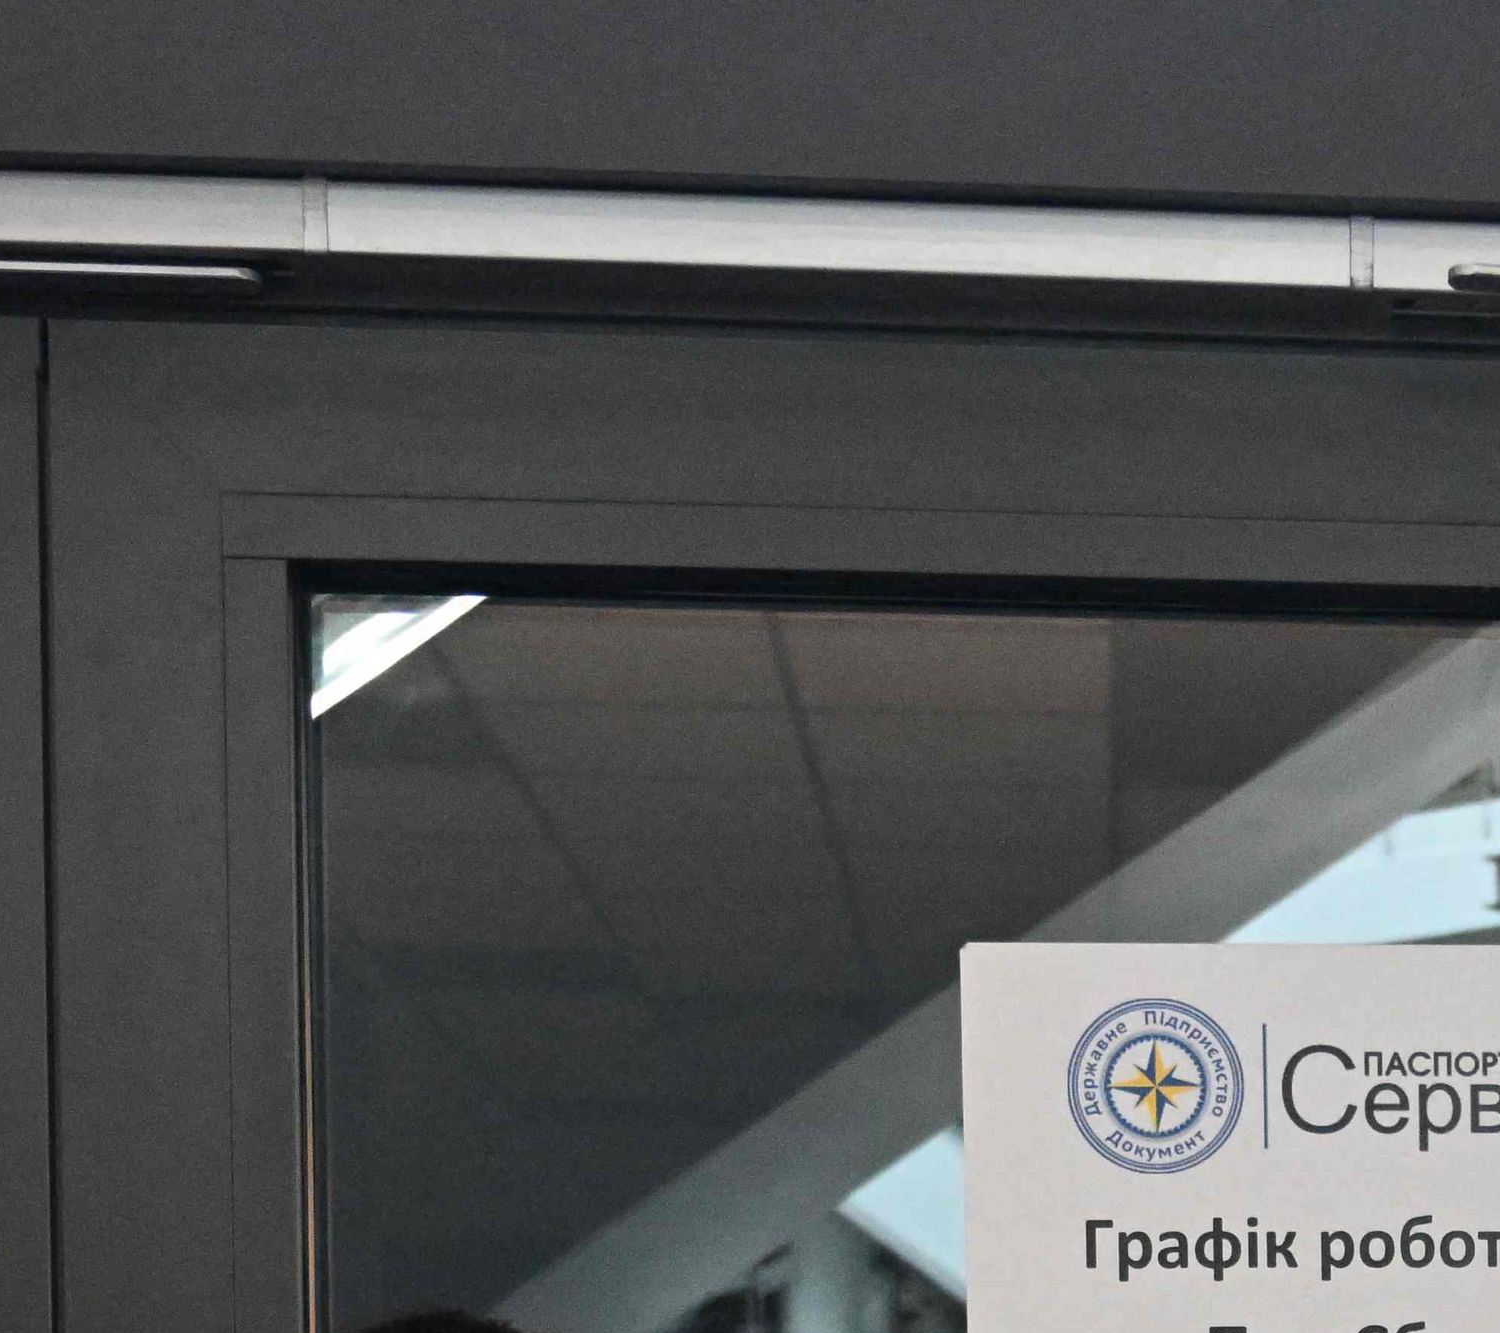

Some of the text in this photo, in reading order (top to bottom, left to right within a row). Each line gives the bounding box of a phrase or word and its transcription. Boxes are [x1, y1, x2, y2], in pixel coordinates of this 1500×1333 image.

[1084, 1011, 1228, 1118] Державне Підприємство
[1105, 1130, 1206, 1161] Документ
[1085, 1216, 1297, 1282] Графік
